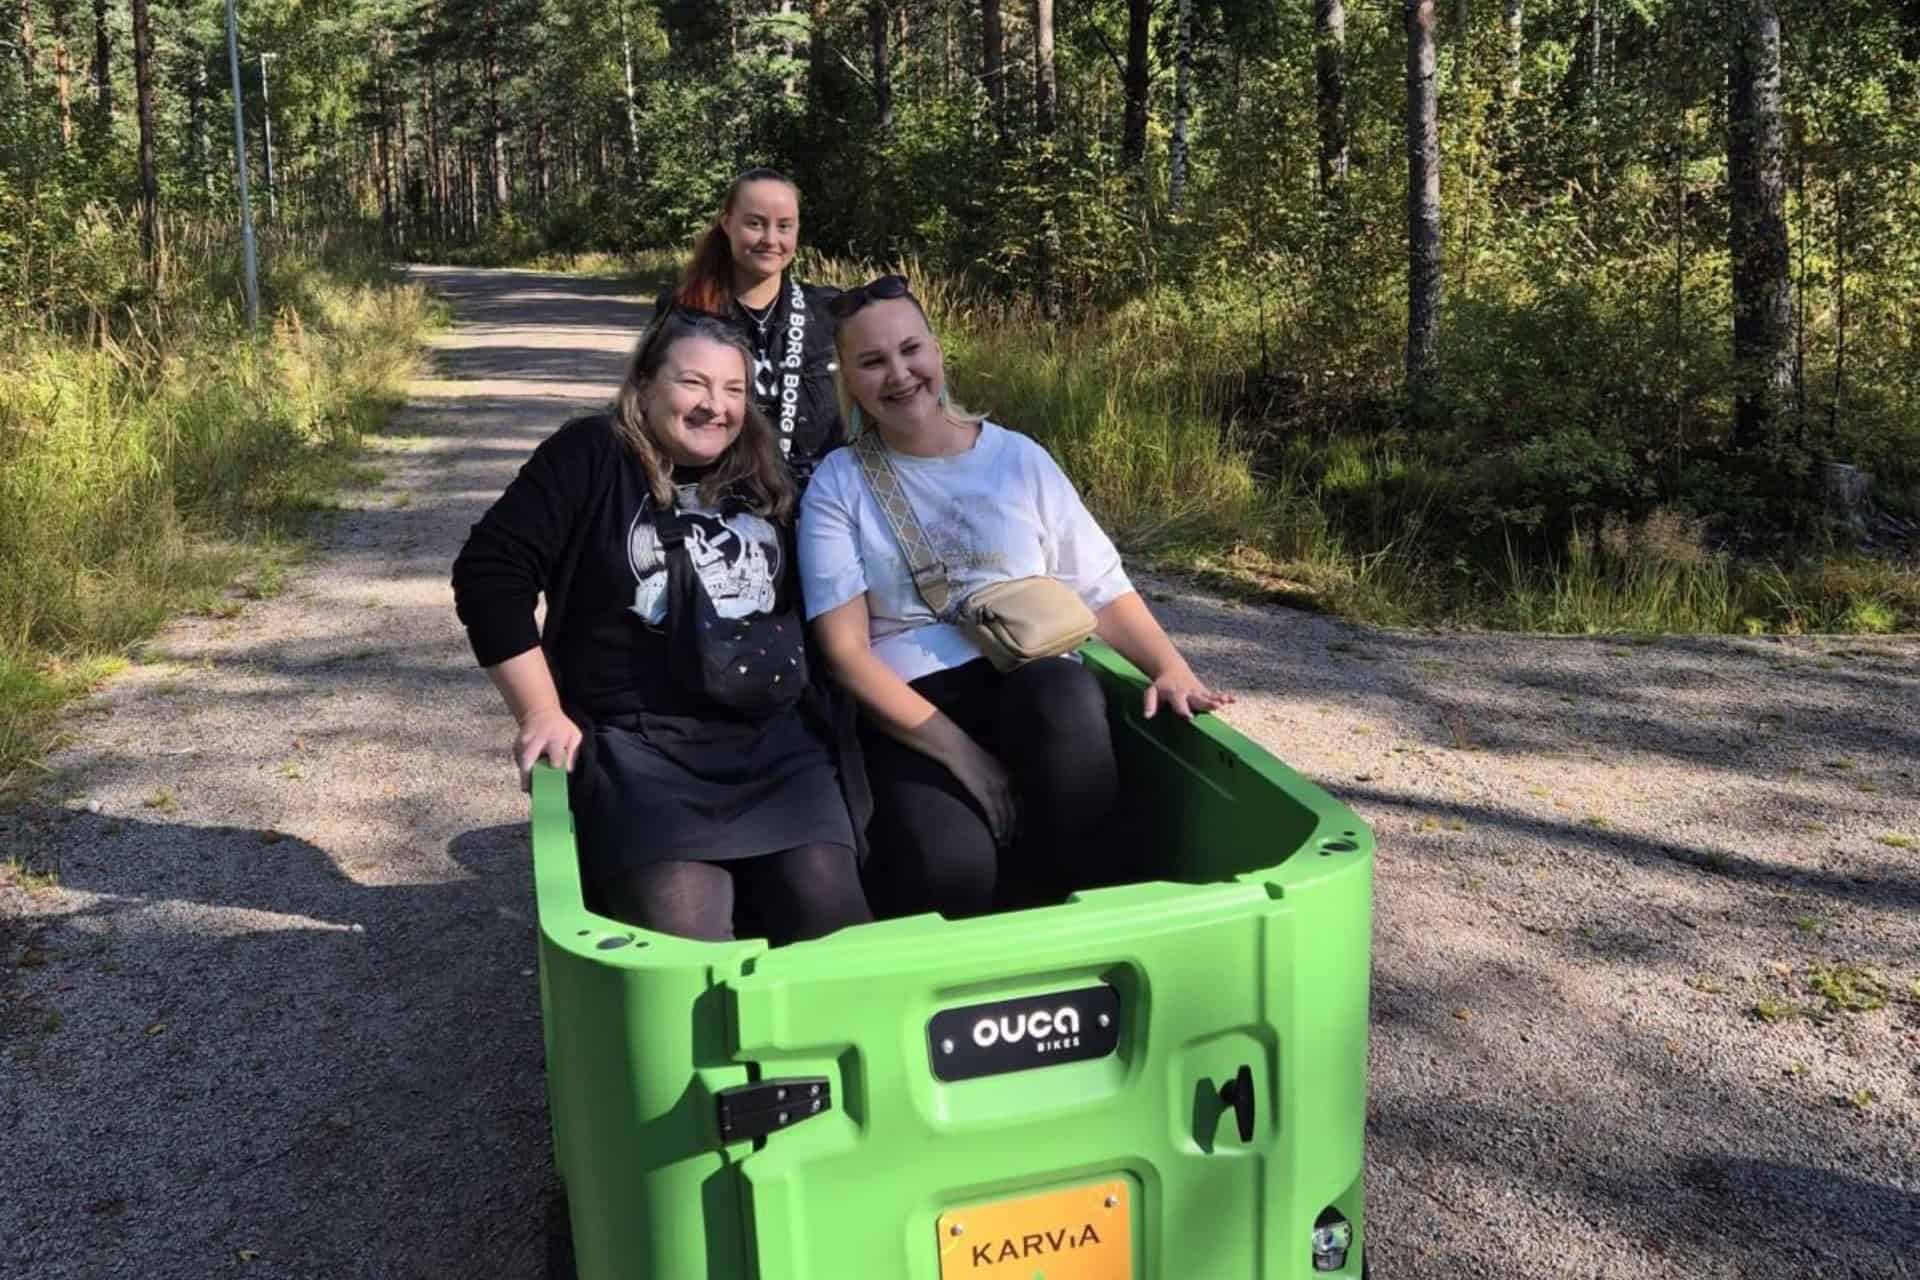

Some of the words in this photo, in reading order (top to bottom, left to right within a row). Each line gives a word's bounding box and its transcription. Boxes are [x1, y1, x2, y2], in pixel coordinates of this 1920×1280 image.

[785, 313, 805, 369] BORG
[780, 373, 799, 433] BORG
[1036, 1036, 1080, 1053] BIKES
